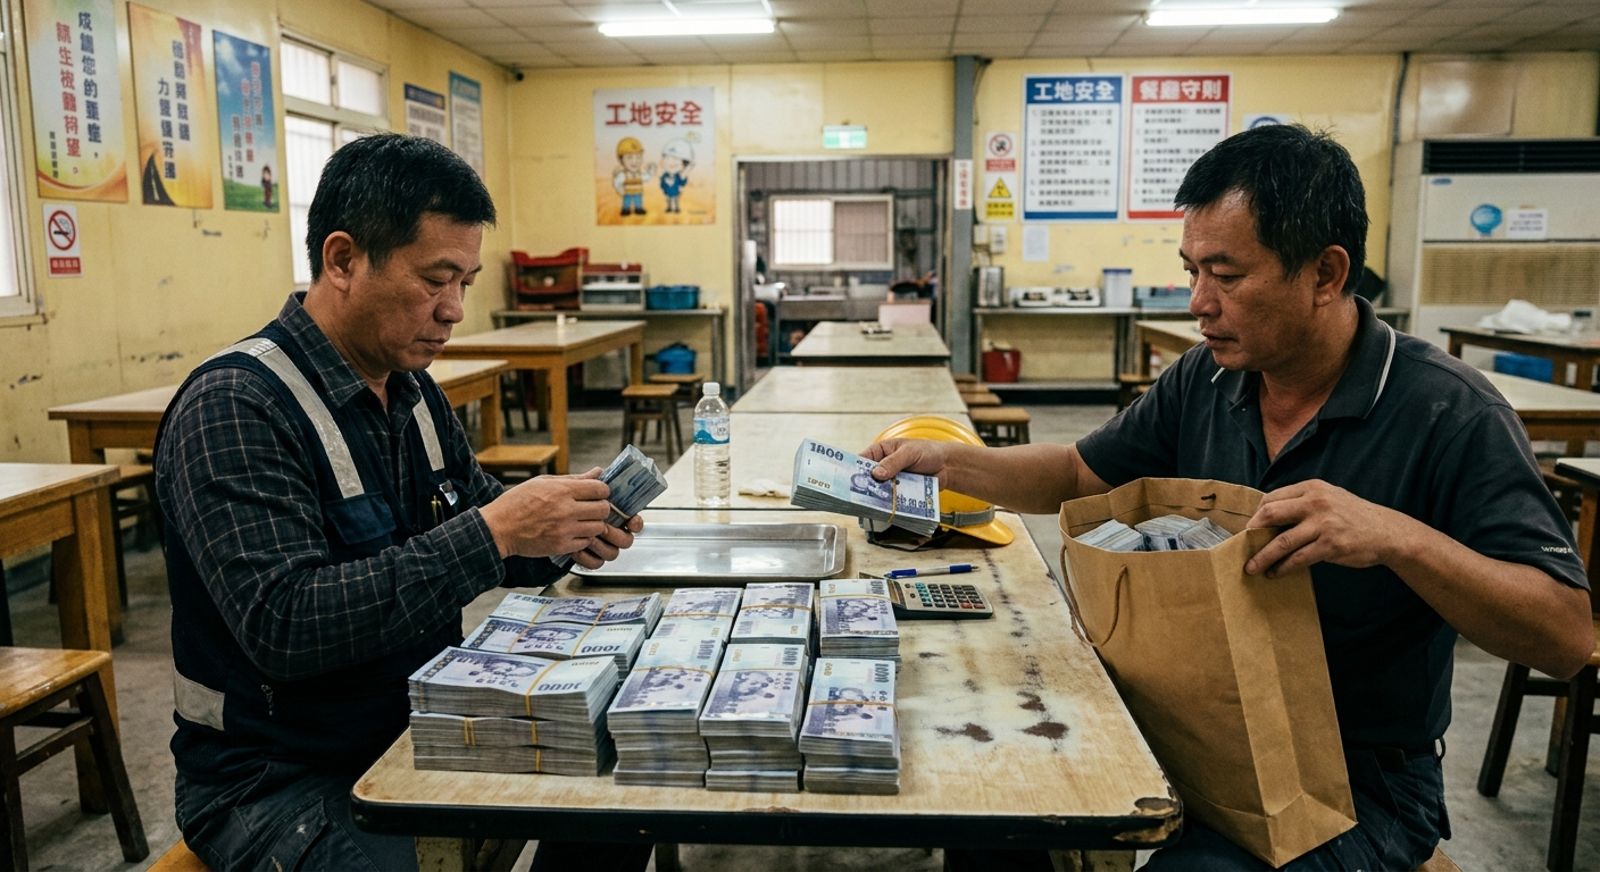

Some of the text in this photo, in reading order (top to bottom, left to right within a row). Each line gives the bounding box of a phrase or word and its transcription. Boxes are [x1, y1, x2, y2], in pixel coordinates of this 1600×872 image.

[1034, 80, 1115, 102] 工地安全
[605, 101, 703, 127] 工地安全
